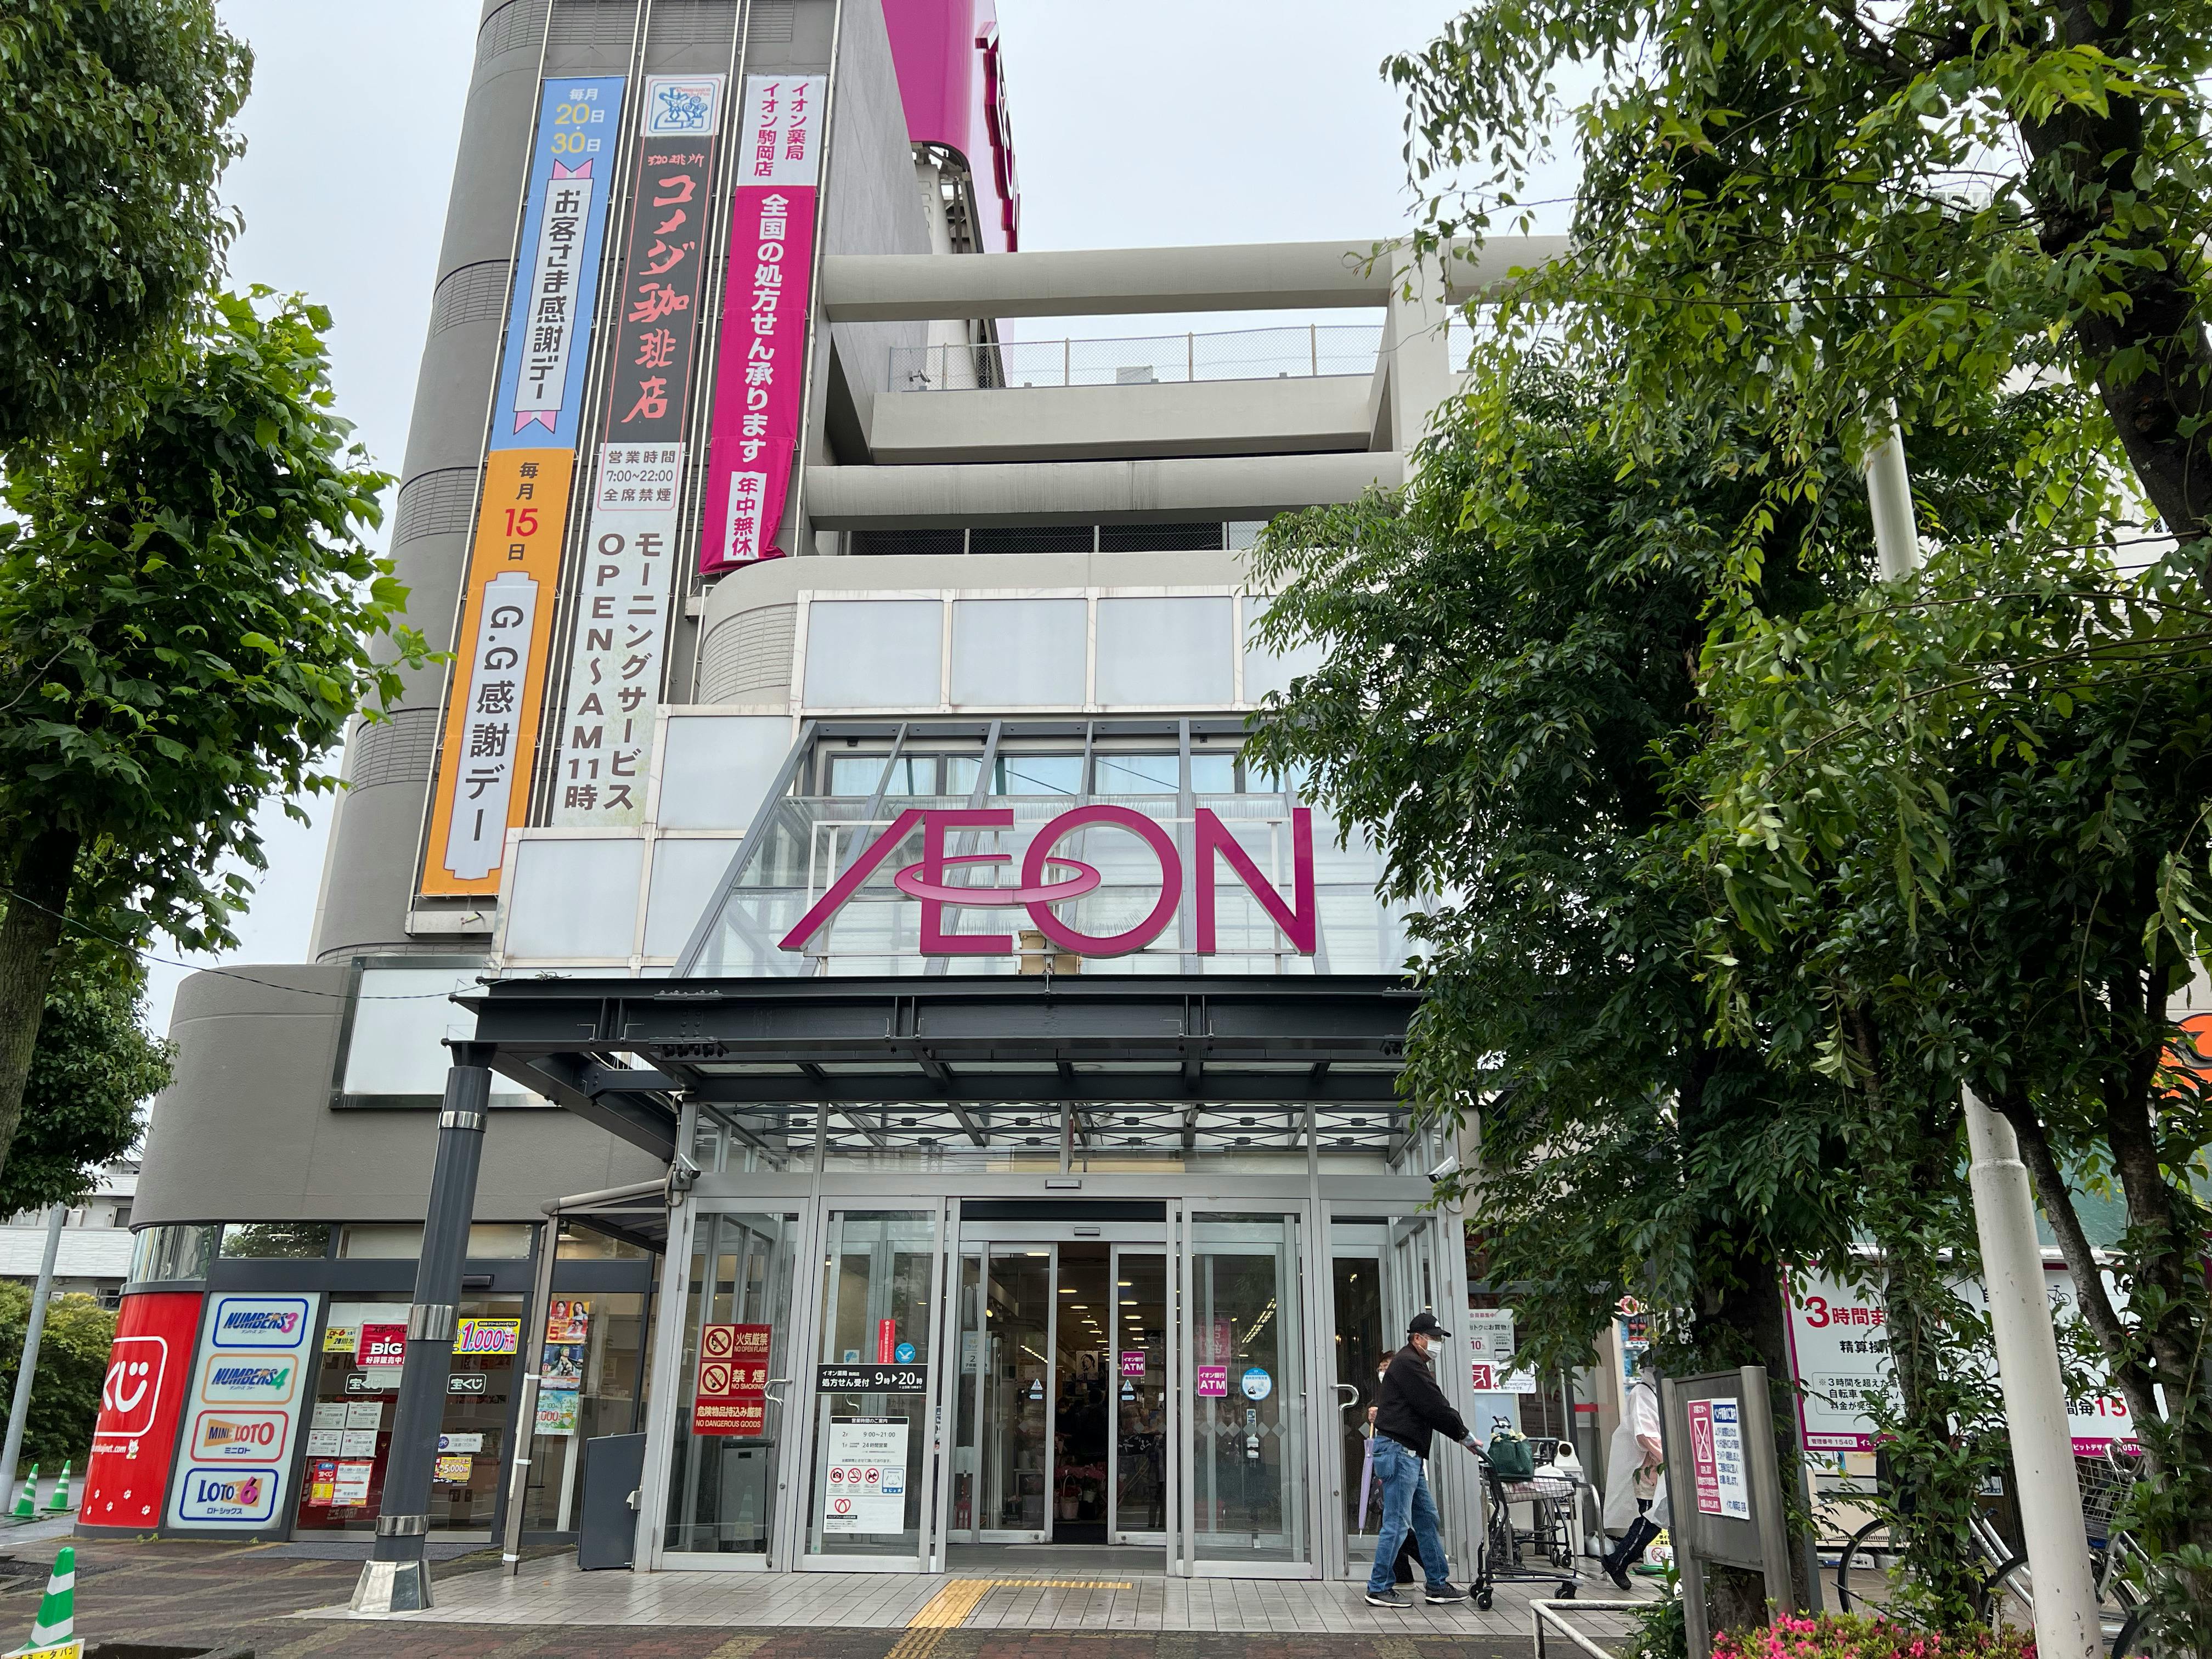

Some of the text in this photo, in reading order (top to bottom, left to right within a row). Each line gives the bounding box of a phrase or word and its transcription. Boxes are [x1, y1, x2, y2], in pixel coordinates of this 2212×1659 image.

[568, 88, 599, 101] 毎月
[555, 104, 605, 125] 20日
[785, 83, 809, 160] イオン薬局
[754, 83, 780, 177] イオン駒岡店
[550, 132, 601, 154] 30日
[648, 153, 705, 167] 珈琲所
[529, 189, 580, 399] お客さま感謝デー
[621, 175, 696, 422] コメダ珈琲店
[742, 194, 789, 462] 全国の処方せん承ります
[608, 450, 676, 464] 営業時間
[603, 488, 672, 501] 全席禁煙
[731, 477, 758, 556] 年中無休
[603, 533, 664, 811] モーニングサービス
[1805, 1296, 1889, 1328] 3時間ま
[736, 1333, 768, 1346] 火気厳禁
[370, 1342, 403, 1355] BIG
[349, 1378, 381, 1390] 宝くじ
[450, 1379, 483, 1390] 宝くじ
[822, 1378, 870, 1387] 処方せん受付
[1200, 1380, 1225, 1390] ATM
[697, 1406, 762, 1418] 危険物品持込み厳禁
[208, 1422, 275, 1446] MINI LOTO
